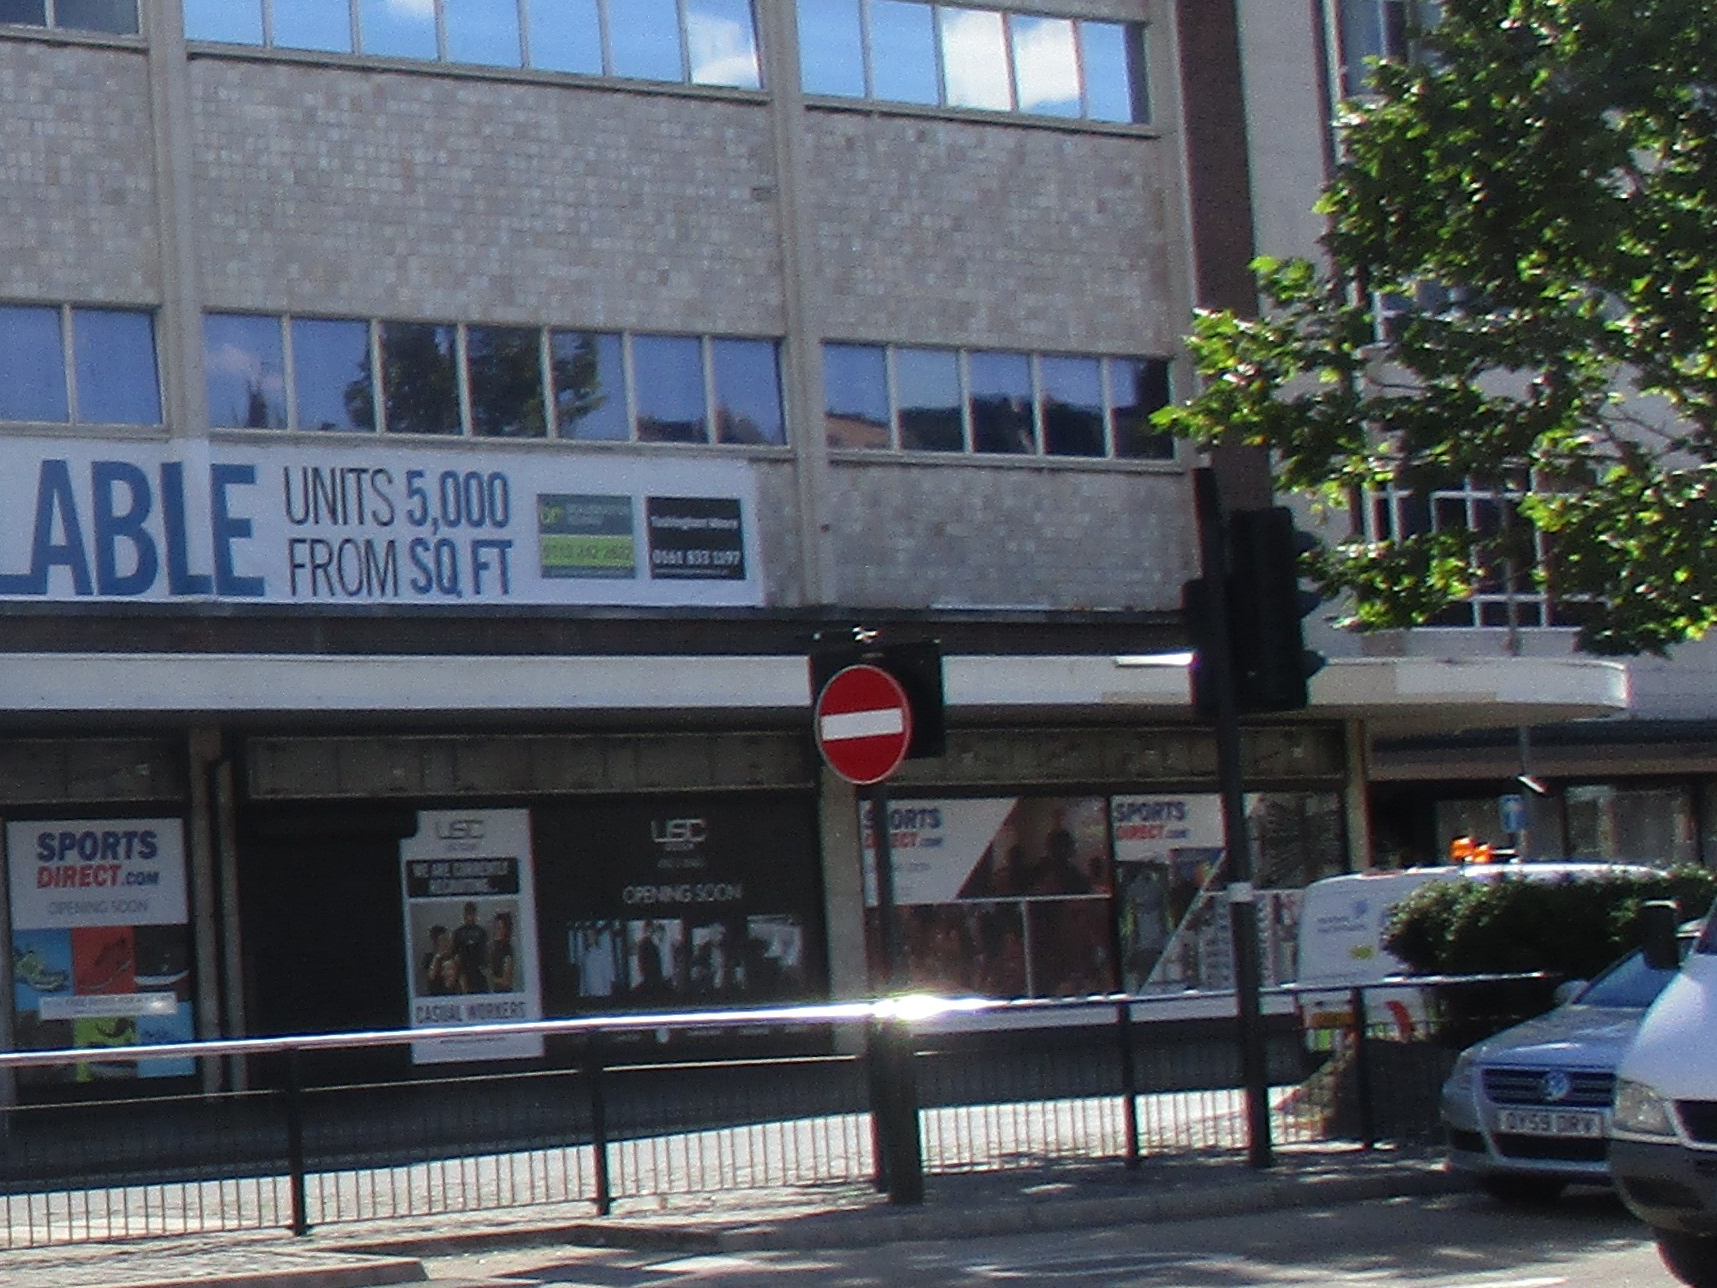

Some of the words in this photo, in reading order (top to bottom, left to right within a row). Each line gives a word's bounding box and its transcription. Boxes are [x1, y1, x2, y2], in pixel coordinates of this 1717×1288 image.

[282, 465, 396, 528] UNITS
[405, 468, 510, 537] 5,000
[287, 537, 399, 598] FROM
[409, 536, 463, 599] SQ
[469, 538, 513, 596] FT
[863, 807, 943, 830] SORTS
[1115, 800, 1187, 823] SPORTS
[36, 829, 159, 862] SPORTS
[621, 884, 693, 904] OPENING
[695, 883, 744, 902] SOON
[416, 1003, 463, 1023] CASUAL
[465, 1000, 526, 1021] WORKERS
